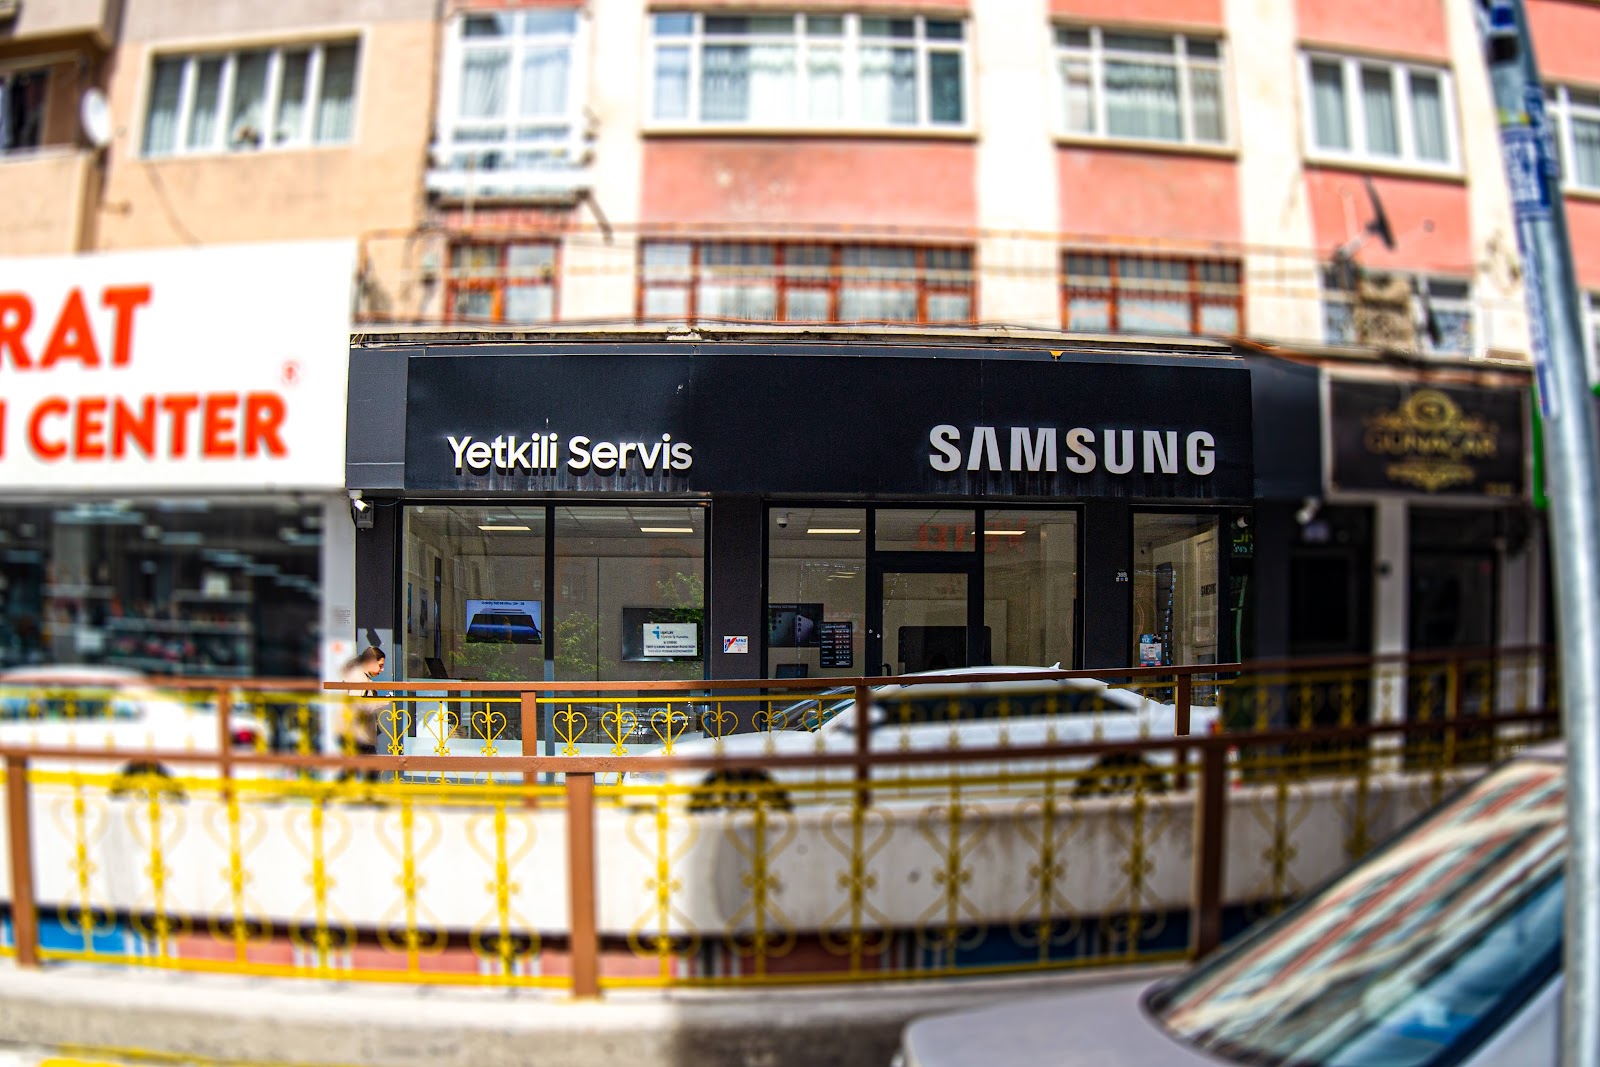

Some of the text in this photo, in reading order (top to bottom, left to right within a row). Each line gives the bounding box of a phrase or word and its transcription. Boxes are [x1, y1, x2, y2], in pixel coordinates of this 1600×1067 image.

[28, 392, 288, 462] CENTER
[446, 432, 693, 471] Yetkili Servis
[928, 424, 1217, 477] SAMSUNG
